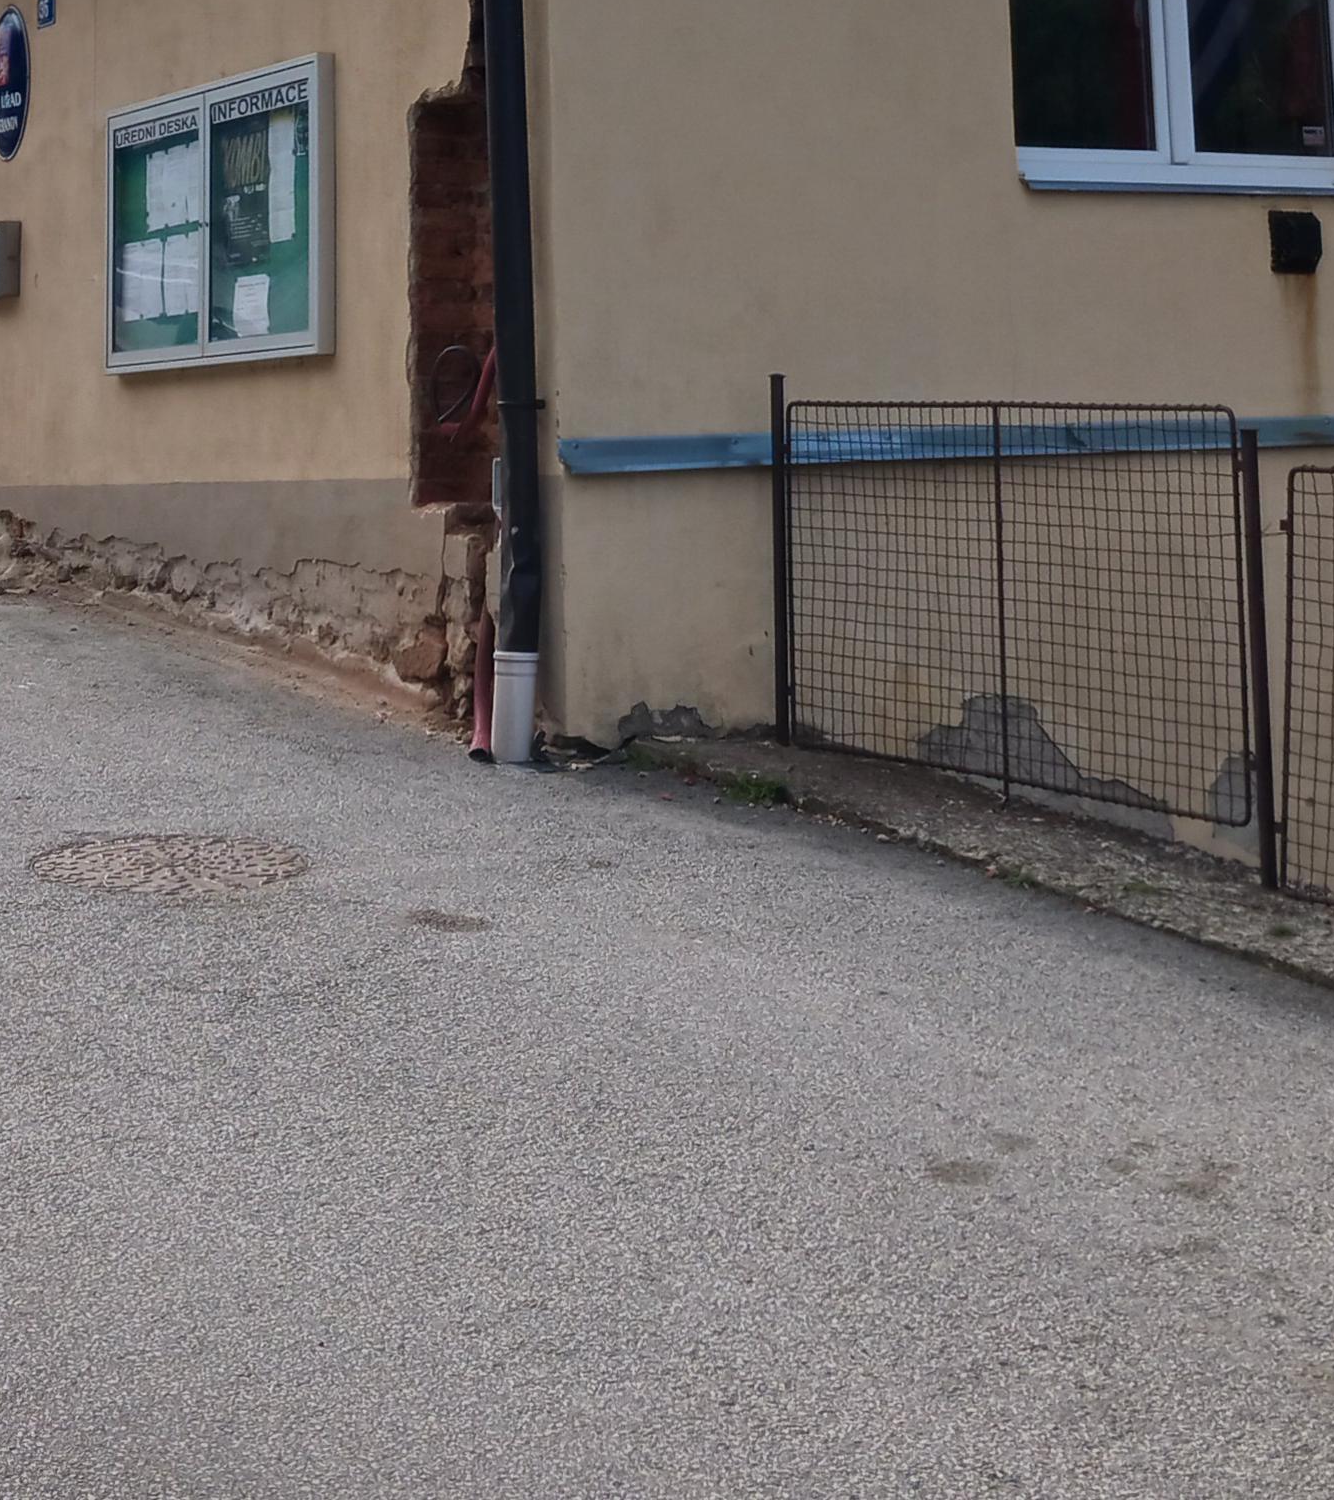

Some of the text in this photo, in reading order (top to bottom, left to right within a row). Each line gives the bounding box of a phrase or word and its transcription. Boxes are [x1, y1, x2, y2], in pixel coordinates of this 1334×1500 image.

[212, 80, 308, 122] INFORMACE
[117, 114, 198, 147] ÚŘEDNÍ DESKA
